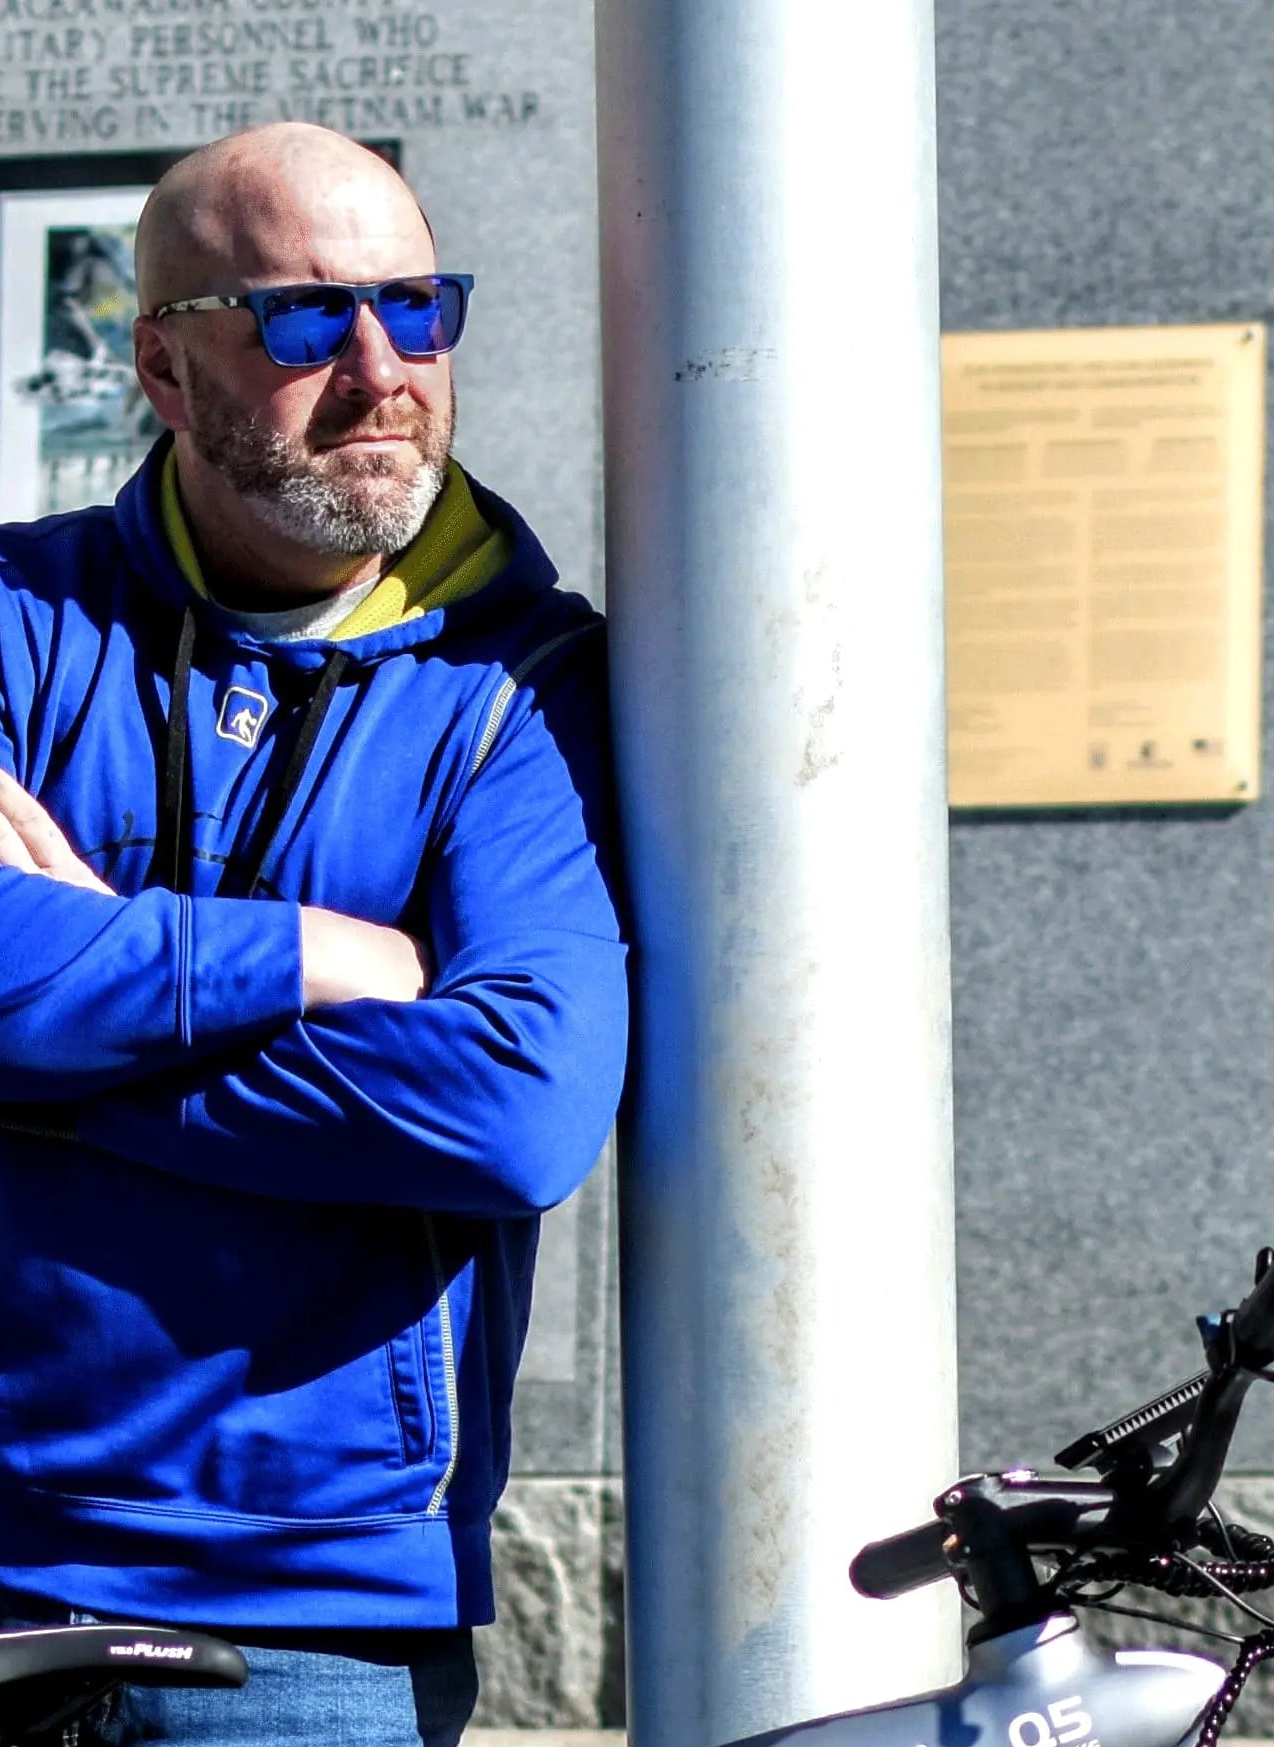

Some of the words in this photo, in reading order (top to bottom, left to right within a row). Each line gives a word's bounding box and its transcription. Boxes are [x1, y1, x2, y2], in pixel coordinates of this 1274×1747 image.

[129, 15, 333, 58] PERSONNEL
[354, 13, 439, 49] WHO
[25, 66, 93, 101] THE
[109, 59, 269, 99] SUPREME
[134, 103, 172, 140] IN
[190, 101, 257, 135] THE
[461, 92, 542, 125] WAR
